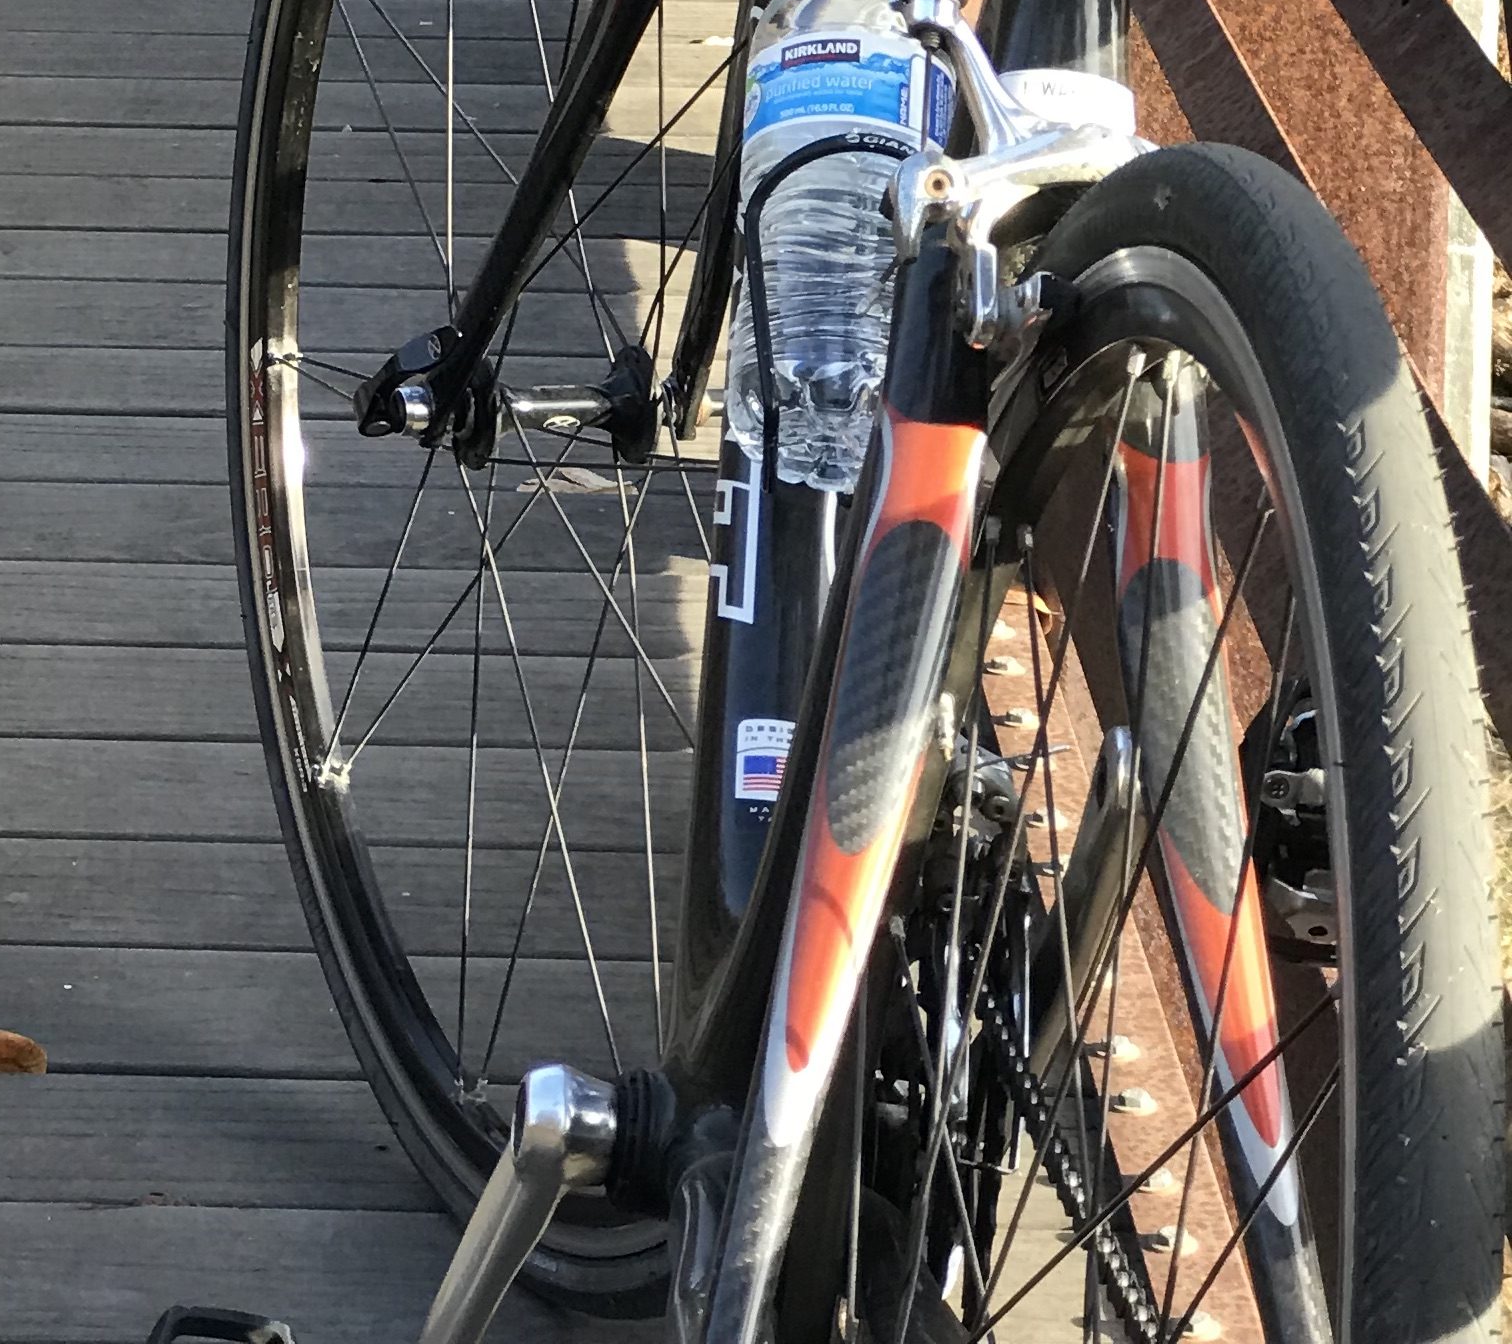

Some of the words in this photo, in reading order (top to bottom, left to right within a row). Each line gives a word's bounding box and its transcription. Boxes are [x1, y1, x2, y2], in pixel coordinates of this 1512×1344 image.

[784, 42, 858, 61] KIRKLAND
[765, 75, 821, 103] purified
[826, 75, 872, 90] water
[862, 135, 915, 155] GIAN
[745, 725, 794, 733] DESI
